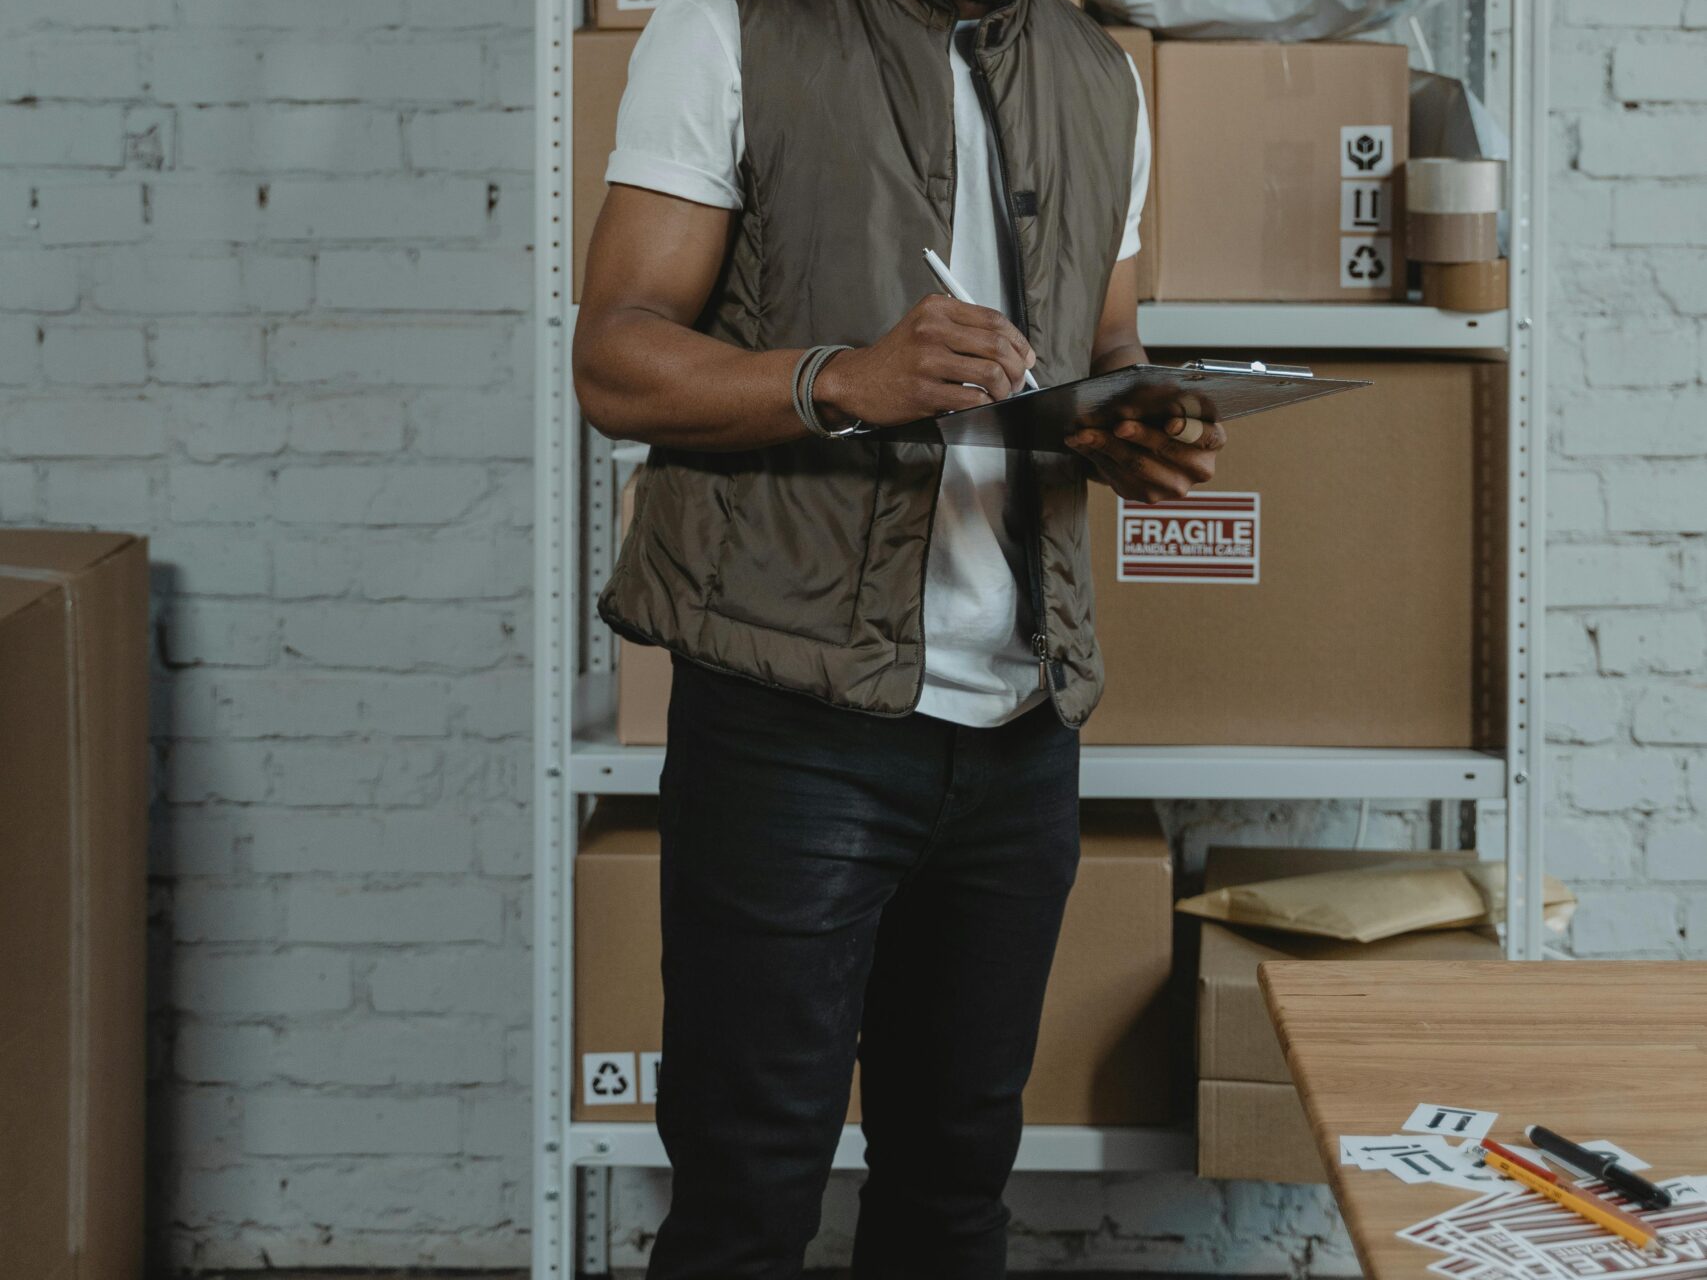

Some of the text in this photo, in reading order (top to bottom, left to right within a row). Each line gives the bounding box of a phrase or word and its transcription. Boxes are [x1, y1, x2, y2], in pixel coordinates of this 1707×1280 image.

[1124, 519, 1253, 544] FRAGILE
[1124, 542, 1252, 557] HANDLE WITH CARE
